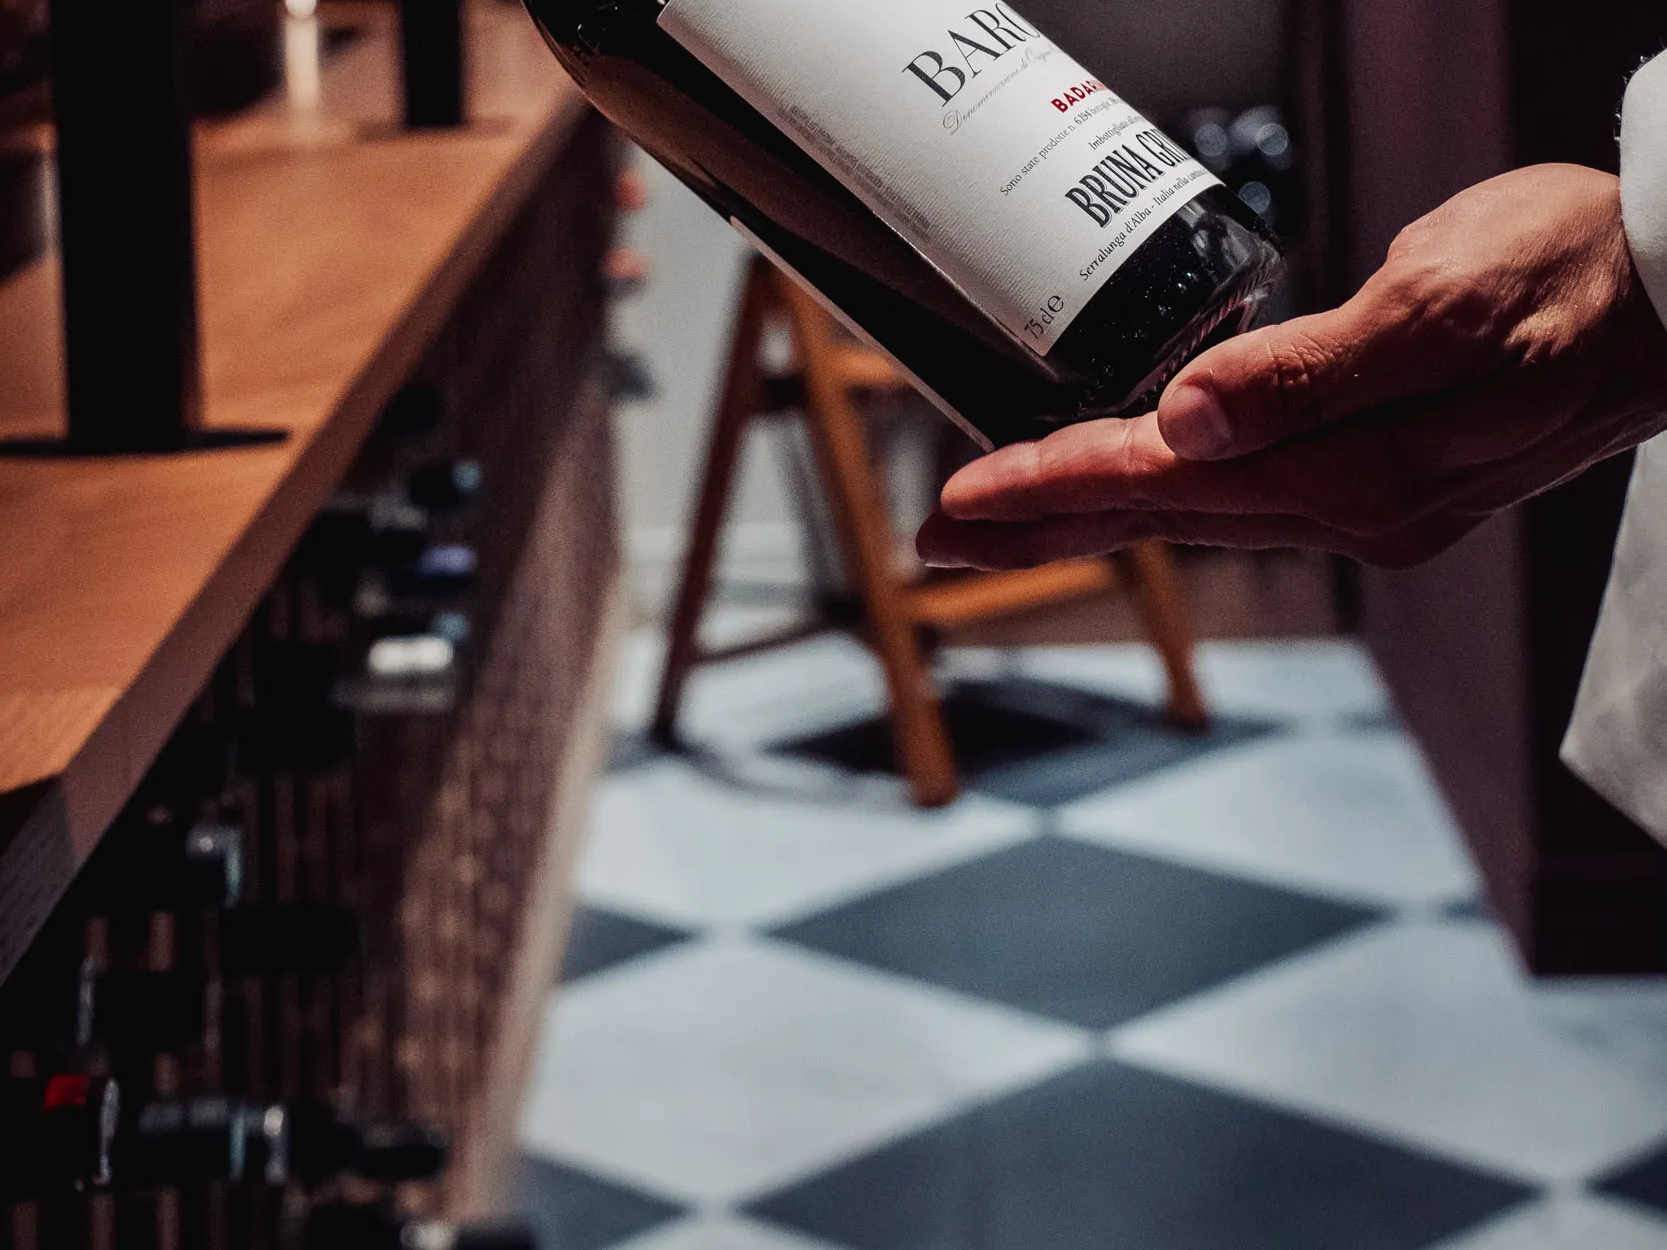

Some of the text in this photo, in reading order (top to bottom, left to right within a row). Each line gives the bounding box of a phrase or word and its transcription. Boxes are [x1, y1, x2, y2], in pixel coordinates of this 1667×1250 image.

[1000, 174, 1022, 196] Sono
[1021, 155, 1040, 175] state
[1038, 129, 1070, 160] prodotte
[1064, 144, 1166, 229] BRUNA
[1079, 231, 1127, 282] Serralunga
[1125, 207, 1152, 234] d'Alba
[1153, 187, 1176, 206] Italia
[1173, 176, 1190, 191] nella
